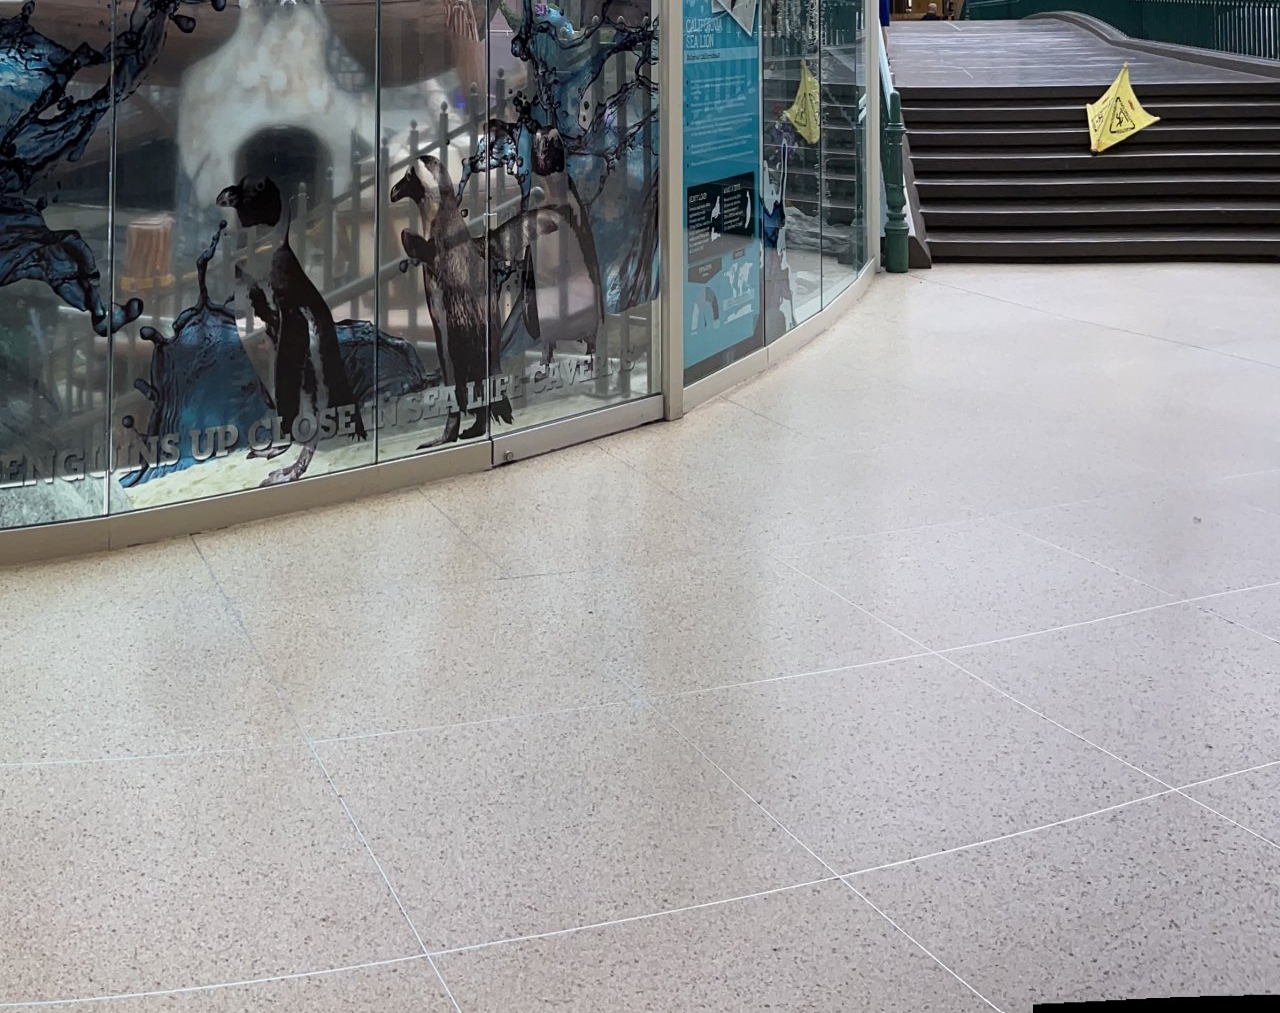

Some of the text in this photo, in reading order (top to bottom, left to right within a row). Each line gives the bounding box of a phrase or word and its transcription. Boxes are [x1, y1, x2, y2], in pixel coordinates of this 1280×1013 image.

[190, 425, 239, 461] UP
[247, 404, 358, 453] CLOSE
[406, 384, 460, 424] SEA
